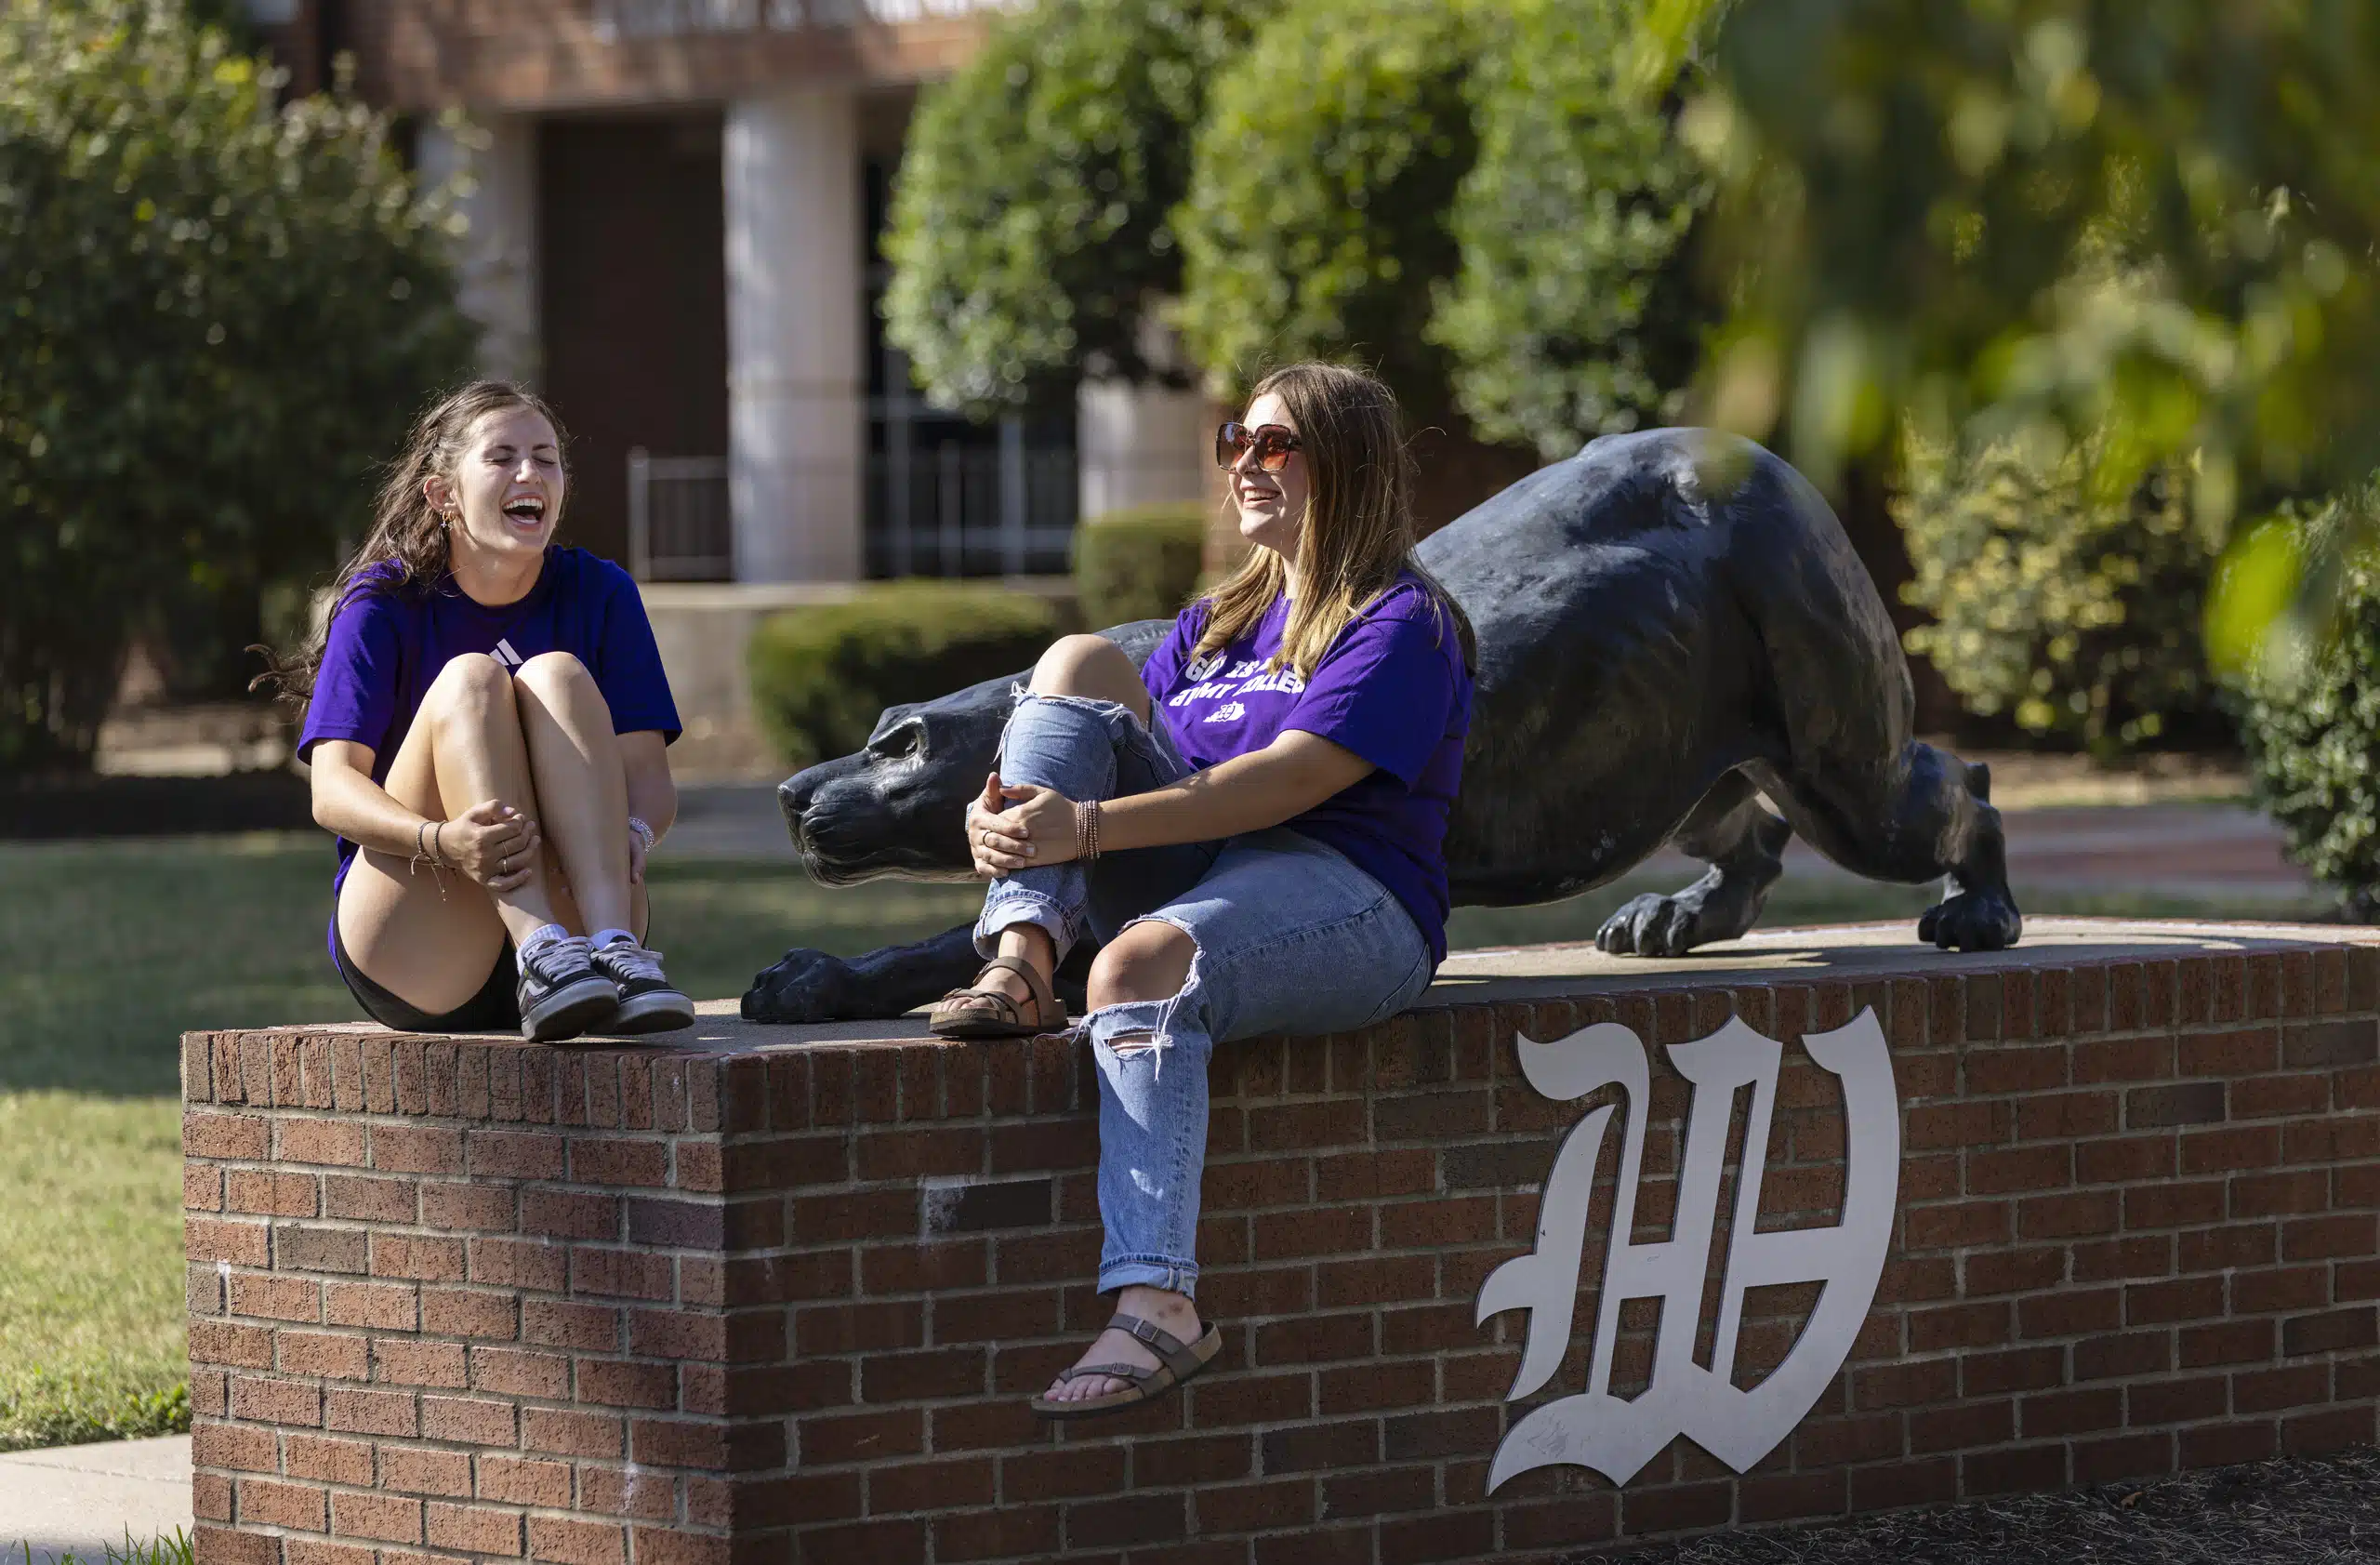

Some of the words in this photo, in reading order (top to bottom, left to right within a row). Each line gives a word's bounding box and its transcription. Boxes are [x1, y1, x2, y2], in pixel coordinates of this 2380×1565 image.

[1224, 660, 1260, 678] IS
[1194, 683, 1238, 698] MY
[1476, 1005, 1900, 1496] W
